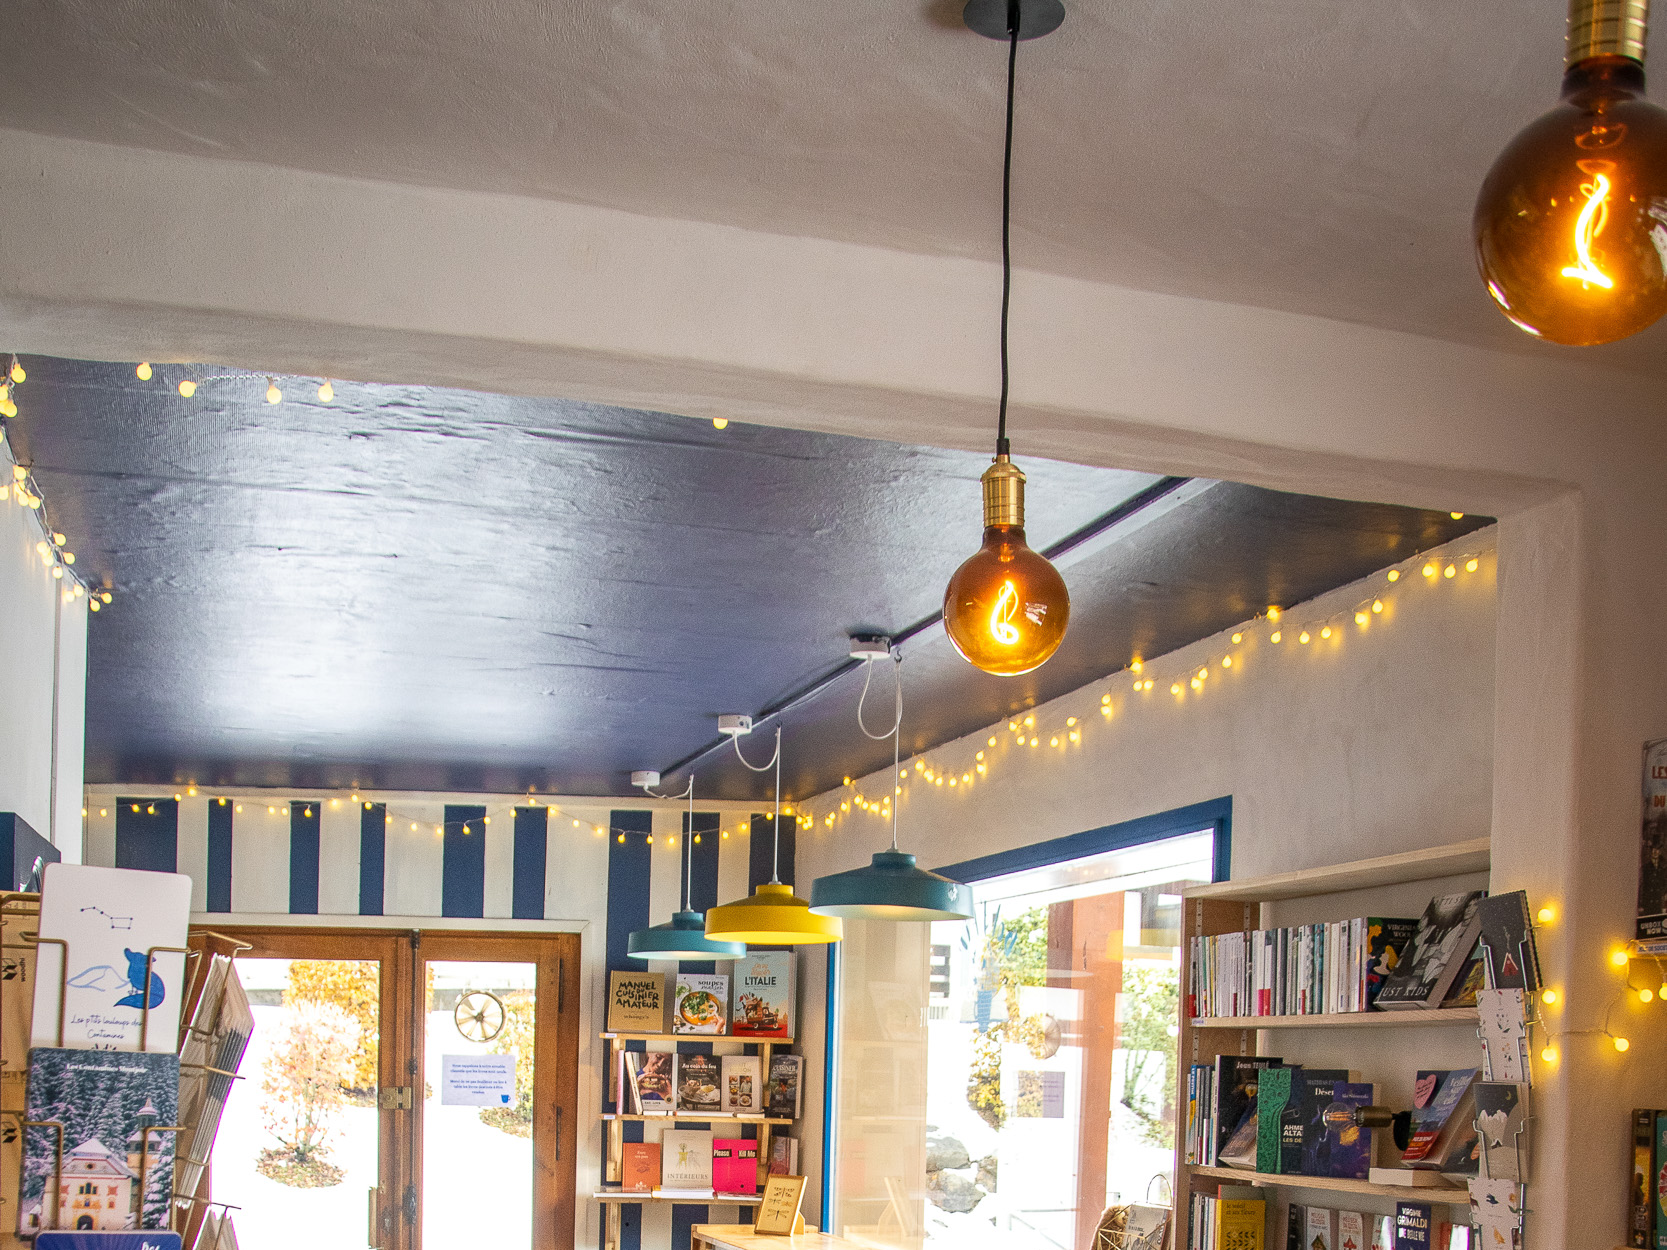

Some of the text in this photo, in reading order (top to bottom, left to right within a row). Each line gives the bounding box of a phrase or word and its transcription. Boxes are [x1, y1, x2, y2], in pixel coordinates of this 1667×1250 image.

[619, 981, 656, 990] MANUEL
[698, 980, 724, 988] soupes
[744, 976, 777, 986] L'ITALIE
[616, 990, 659, 1001] CUISINIER
[1403, 986, 1430, 997] KIDS
[616, 998, 659, 1010] AMATEUR
[1315, 1087, 1334, 1096] Déser
[1397, 1215, 1428, 1229] GRIMALDI
